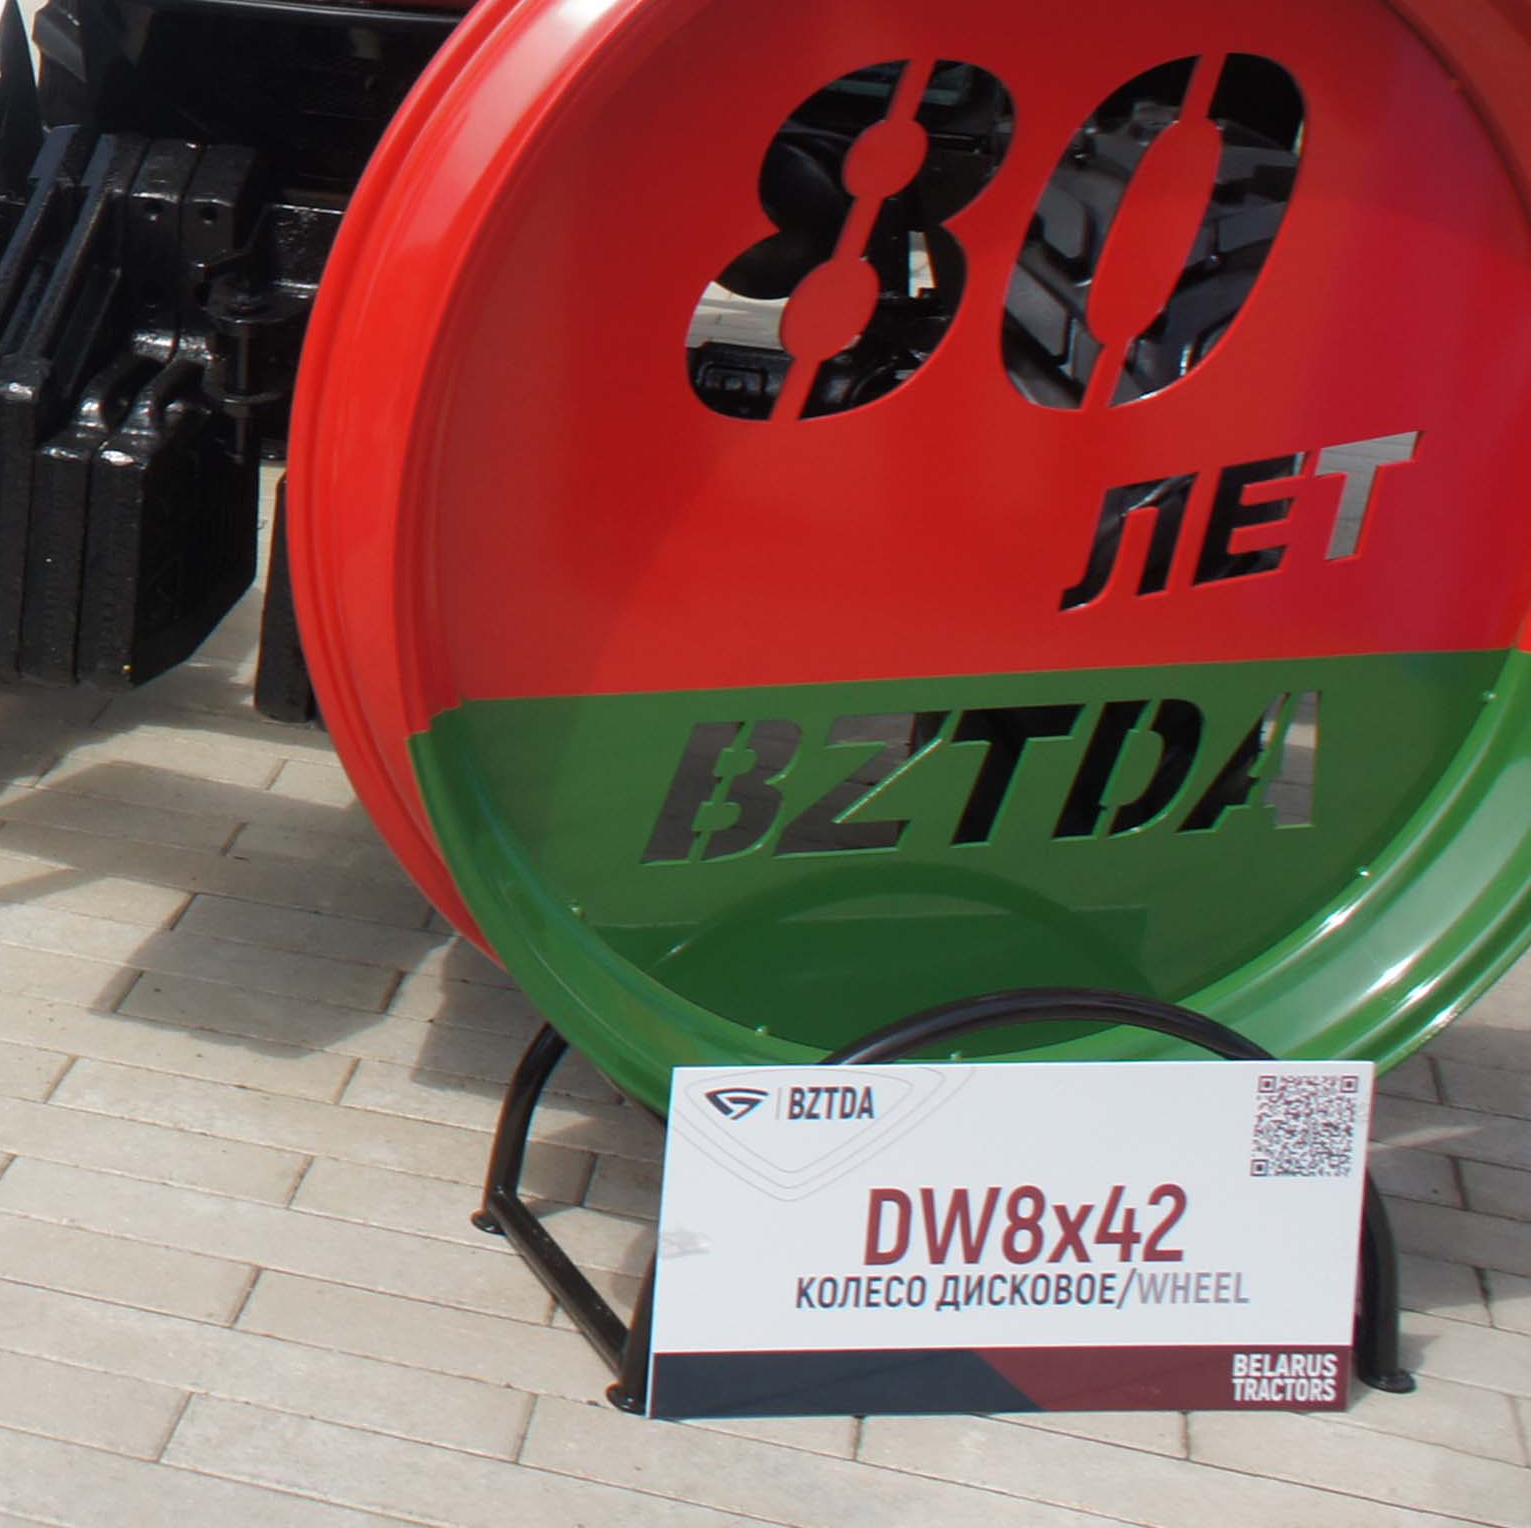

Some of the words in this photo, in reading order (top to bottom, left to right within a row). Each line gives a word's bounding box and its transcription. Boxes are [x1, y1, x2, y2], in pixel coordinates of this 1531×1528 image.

[685, 52, 1310, 422] 80
[1058, 430, 1423, 612] ЛЕТ
[641, 690, 1323, 865] BZTDA
[787, 1085, 875, 1120] BZTDA
[863, 1183, 1189, 1266] DW8x42
[795, 1275, 928, 1309] КОЛЕСО
[935, 1268, 1251, 1312] ДИСКОВОЕ/WHEEL
[1231, 1377, 1337, 1402] TRACTORS
[1232, 1353, 1338, 1377] BELARUS
